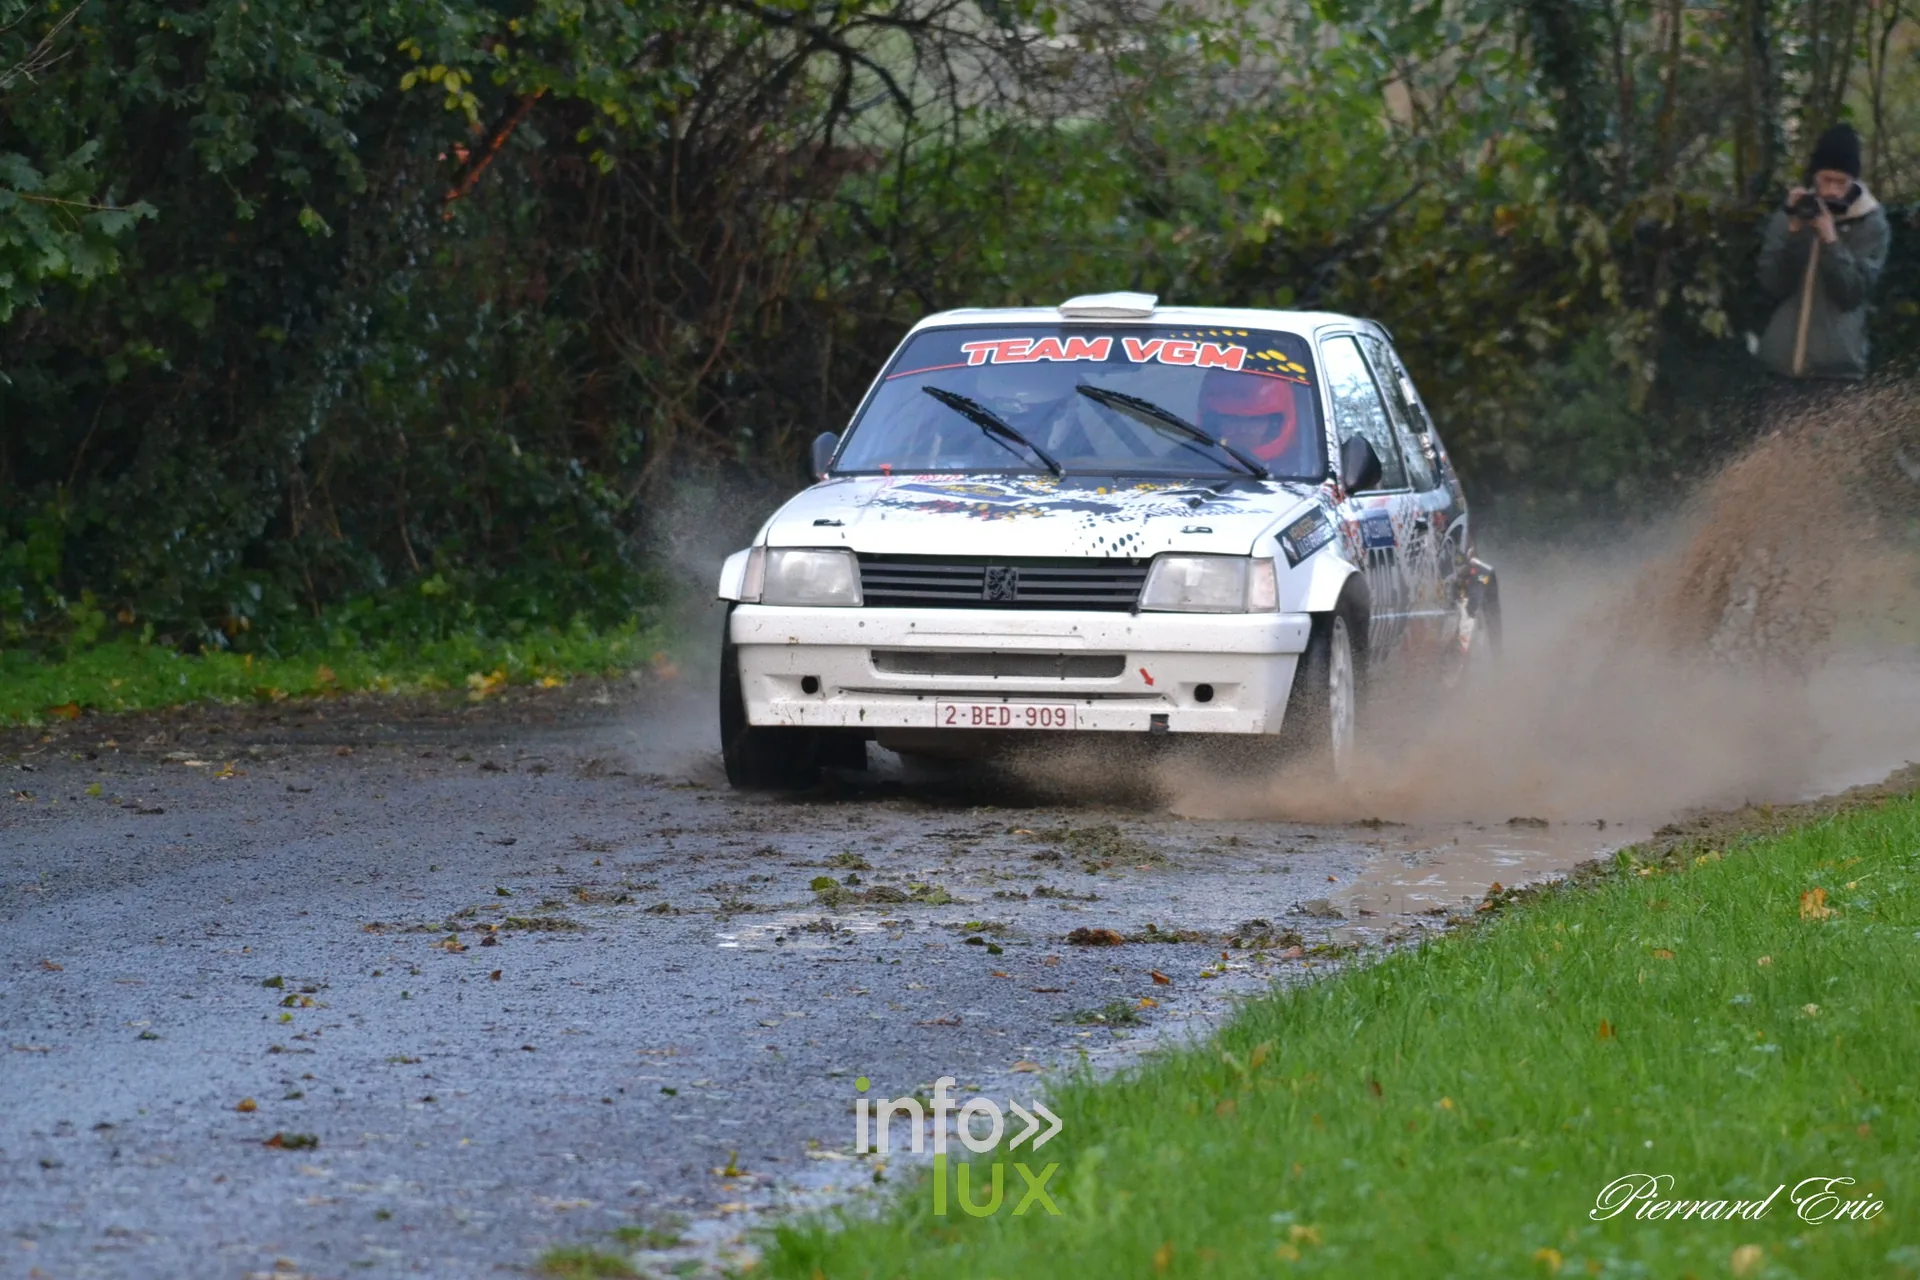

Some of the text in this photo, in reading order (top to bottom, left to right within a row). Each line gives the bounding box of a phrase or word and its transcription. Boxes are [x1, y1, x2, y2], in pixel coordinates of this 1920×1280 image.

[961, 337, 1247, 371] TEAM VGM
[945, 705, 1066, 727] 2-BED-909
